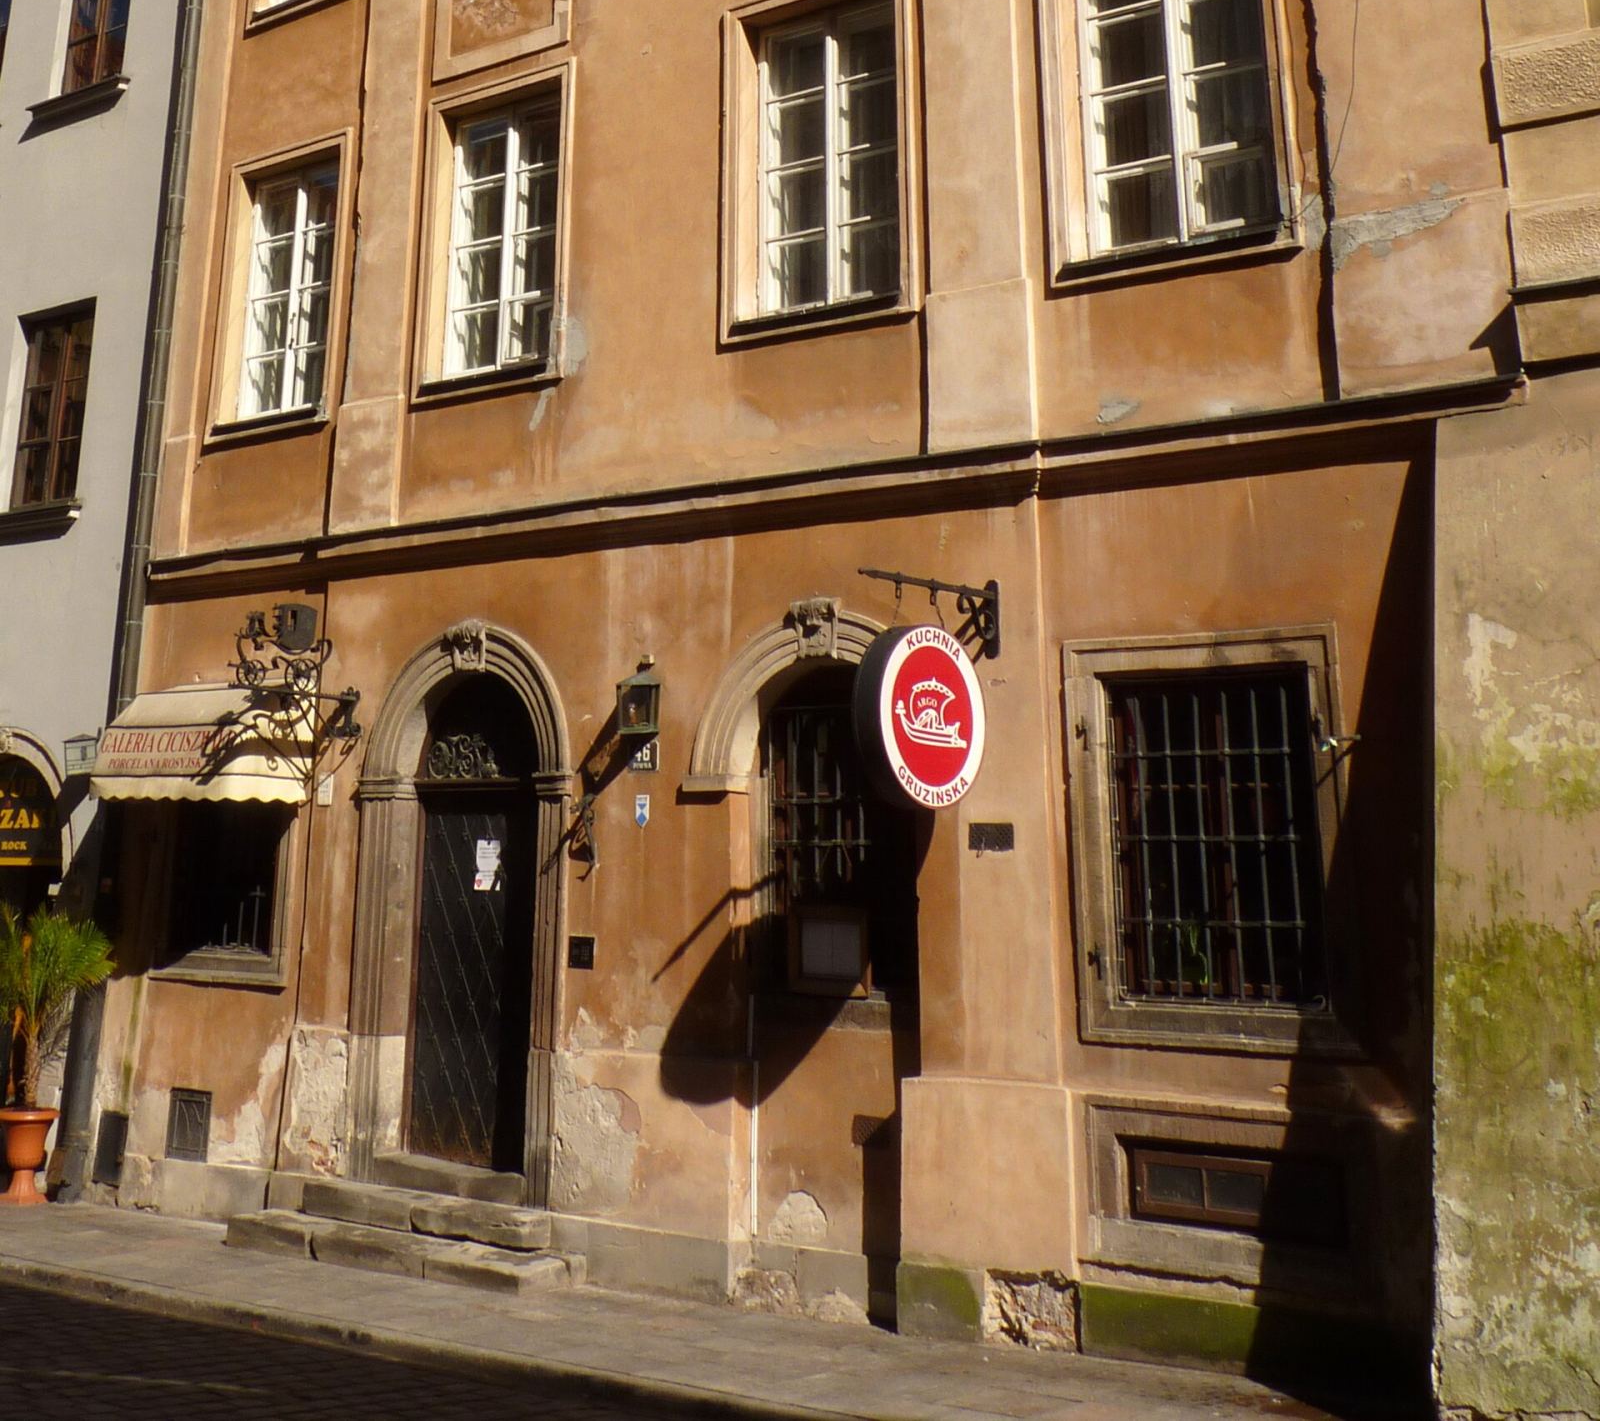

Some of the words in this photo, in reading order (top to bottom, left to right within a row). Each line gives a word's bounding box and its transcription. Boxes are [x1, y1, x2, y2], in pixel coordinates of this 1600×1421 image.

[905, 629, 961, 662] KUCHNIA
[916, 696, 938, 709] ARGO
[101, 731, 154, 754] GALERIA
[108, 757, 161, 770] PORCELANA
[162, 756, 207, 769] ROSYJSK
[898, 765, 969, 805] GRUZIŃSKA
